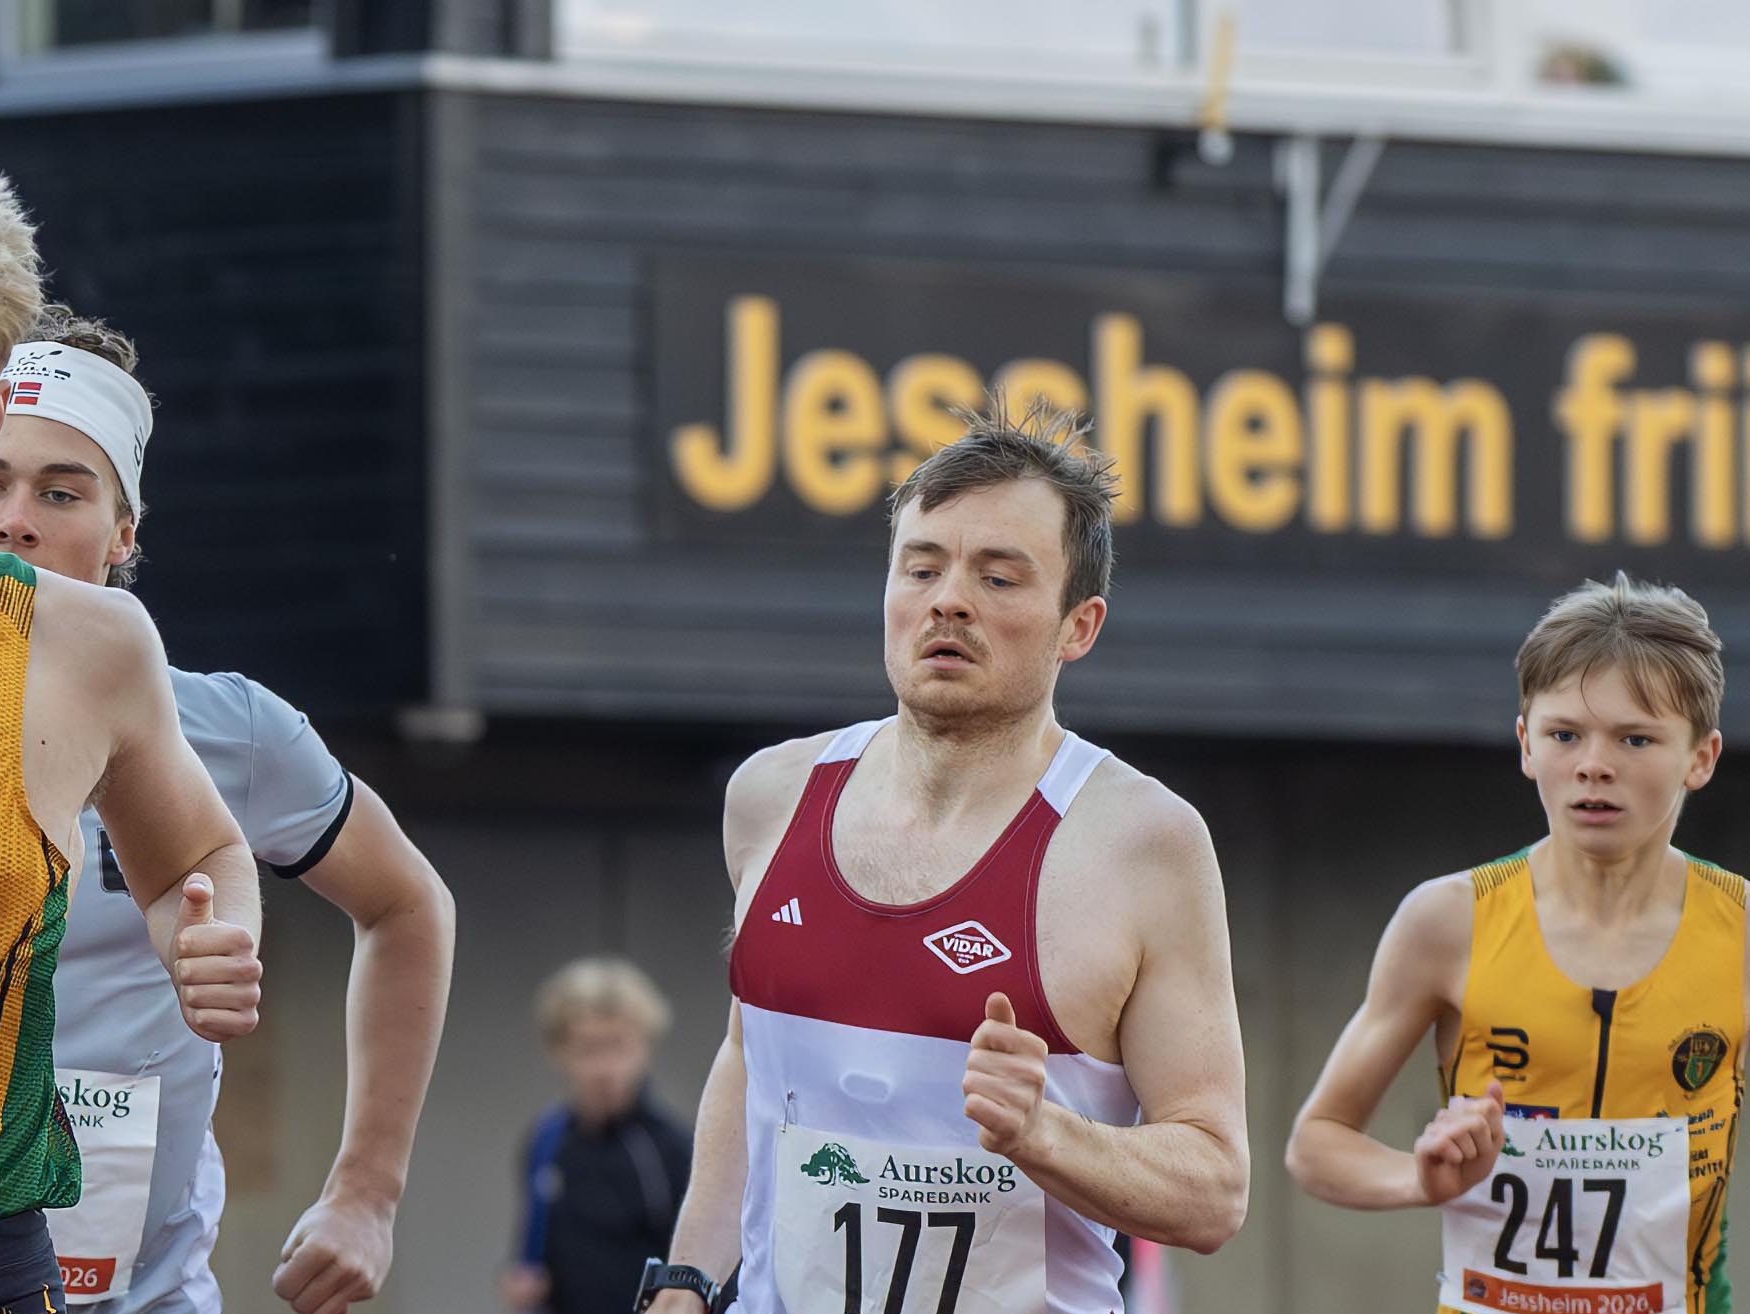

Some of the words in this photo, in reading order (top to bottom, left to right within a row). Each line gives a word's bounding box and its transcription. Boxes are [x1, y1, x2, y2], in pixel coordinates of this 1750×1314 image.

[1553, 330, 1750, 549] fri
[942, 936, 994, 958] VIDAR
[58, 1078, 132, 1118] skog
[1535, 1126, 1665, 1158] Aurskog
[879, 1154, 1017, 1192] Aurskog
[879, 1186, 992, 1204] SPAREBANK
[1490, 1172, 1627, 1280] 247
[60, 1266, 98, 1287] 026
[1499, 1288, 1592, 1314] Jessheim
